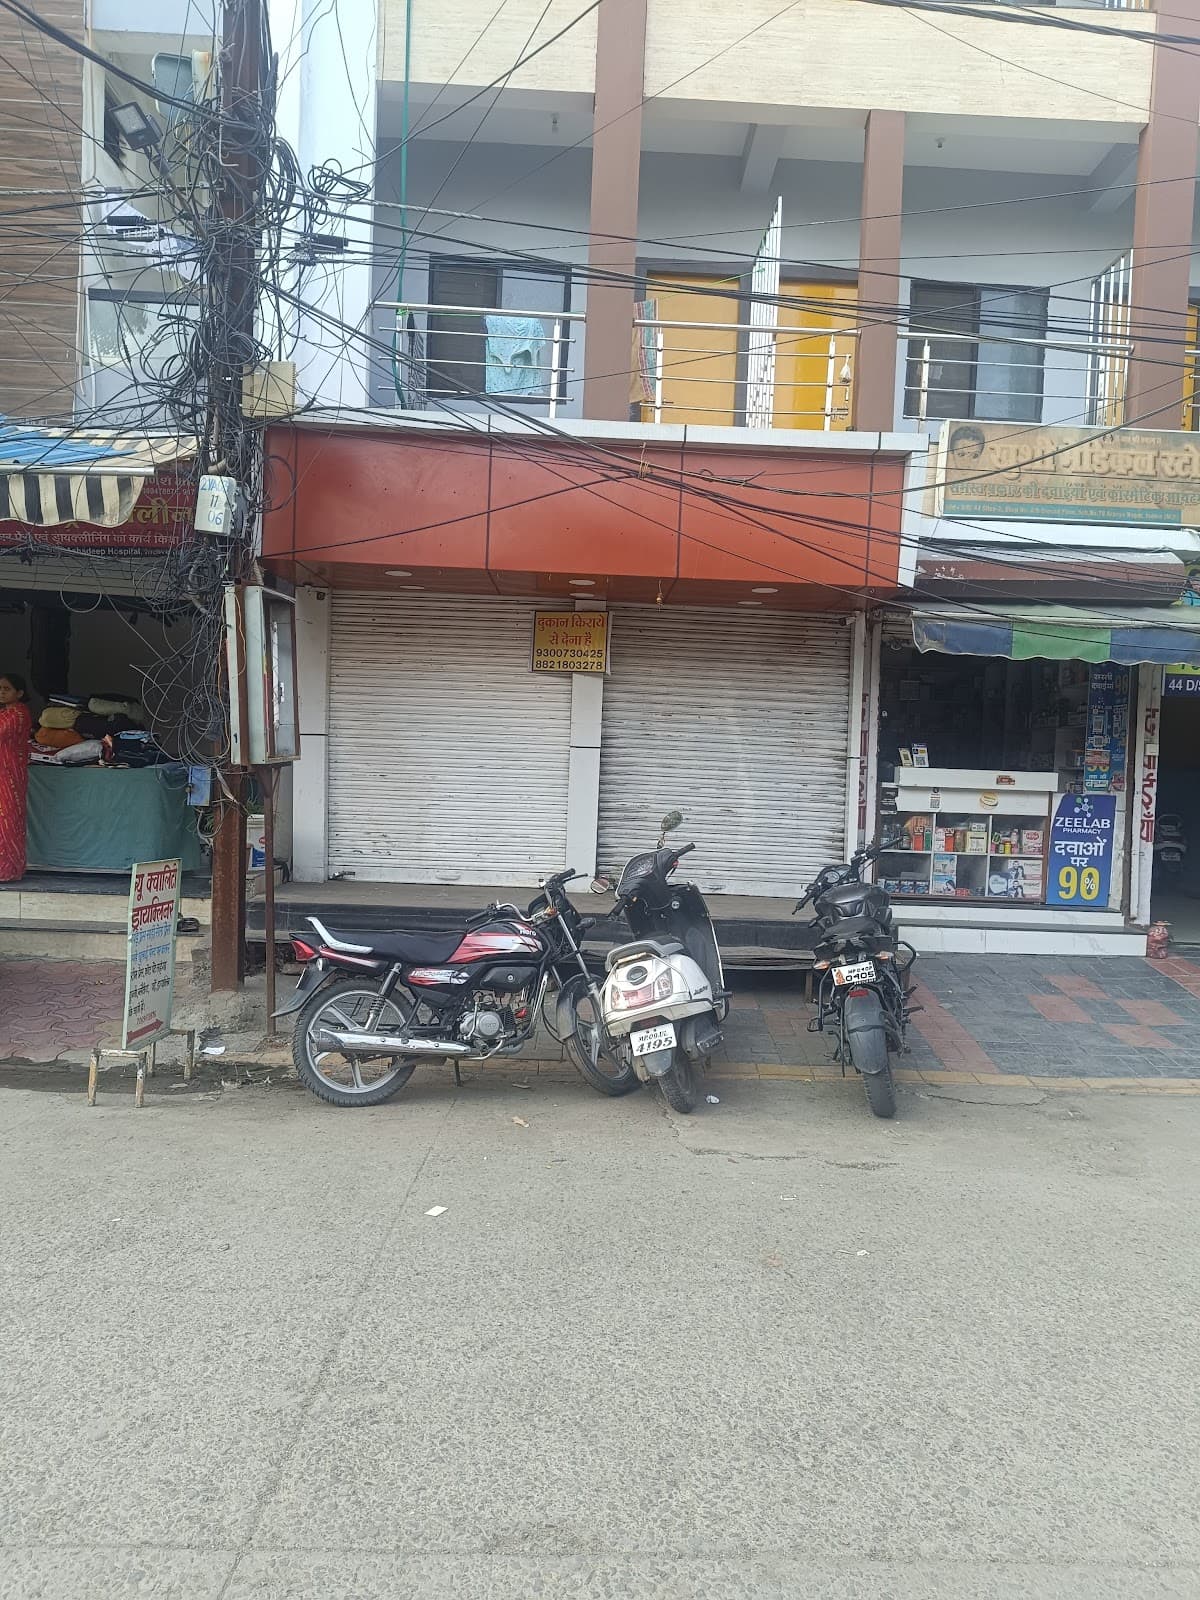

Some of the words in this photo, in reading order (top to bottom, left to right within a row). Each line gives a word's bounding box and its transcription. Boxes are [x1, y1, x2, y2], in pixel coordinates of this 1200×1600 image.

[1159, 443, 1200, 480] स्टो
[537, 617, 569, 631] दुकान
[571, 614, 605, 629] किराये
[549, 632, 559, 646] से
[561, 632, 582, 647] देना
[583, 631, 593, 647] है
[536, 648, 603, 658] 9300730425
[535, 660, 603, 670] 8821803278
[1168, 679, 1183, 691] 44
[1055, 816, 1111, 829] ZEELAB
[1062, 827, 1102, 835] PHARMACY
[1054, 836, 1108, 857] दवाओं
[1070, 856, 1090, 867] पर
[635, 1036, 673, 1053] 4195
